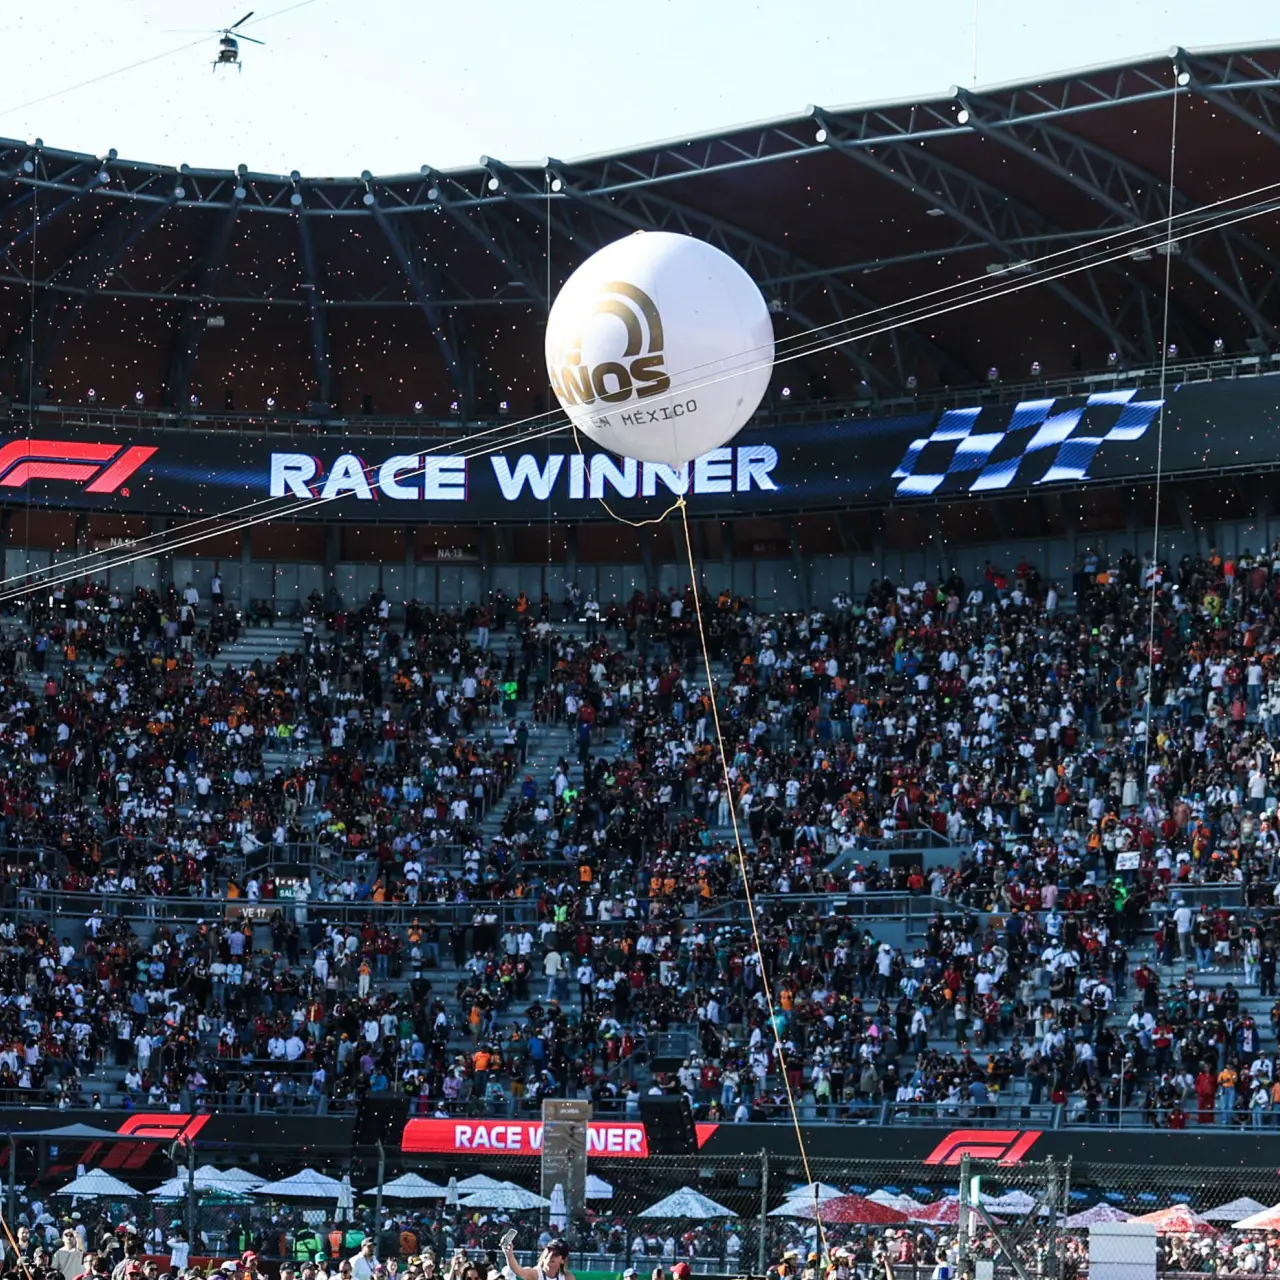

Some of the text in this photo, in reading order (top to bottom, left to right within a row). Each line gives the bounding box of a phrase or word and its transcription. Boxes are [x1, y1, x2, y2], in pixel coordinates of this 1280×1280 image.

[621, 399, 698, 427] MÉXICO
[269, 445, 780, 502] RACE WINNER
[455, 1124, 521, 1152] RACE
